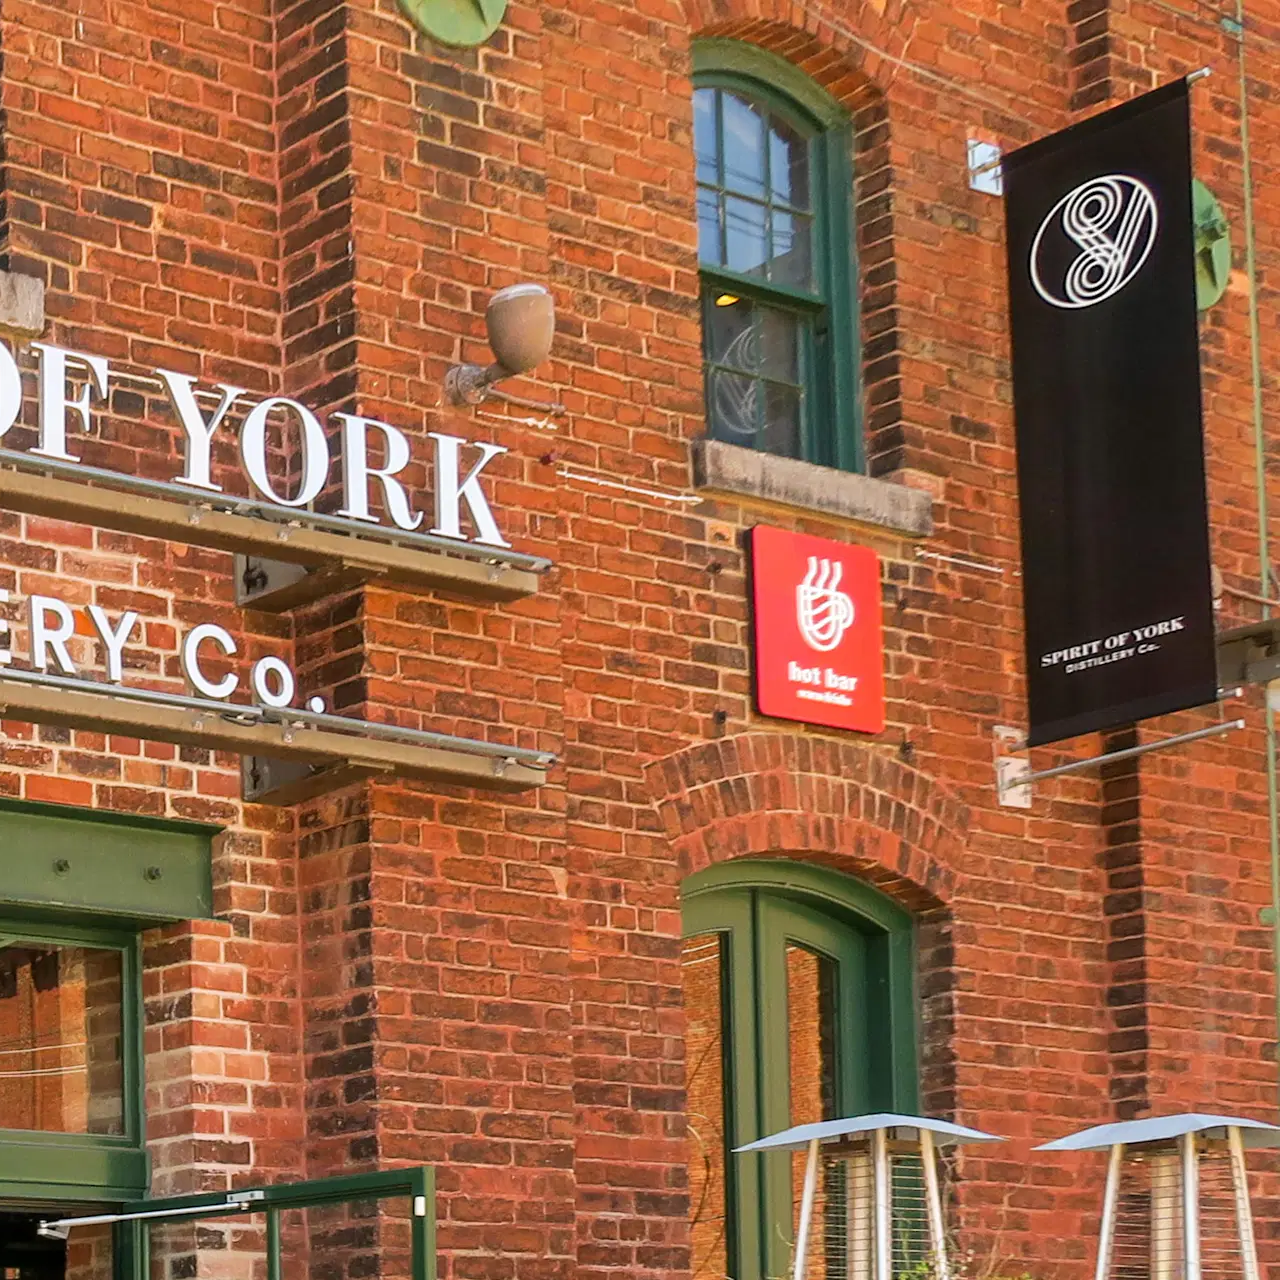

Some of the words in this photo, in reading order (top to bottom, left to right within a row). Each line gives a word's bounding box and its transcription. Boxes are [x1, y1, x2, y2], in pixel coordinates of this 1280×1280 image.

[155, 367, 512, 548] YORK
[1041, 640, 1102, 667] SPIRIT
[1104, 632, 1130, 649] OF
[1133, 616, 1185, 641] YORK
[1065, 648, 1136, 673] DISTILLERY
[1138, 643, 1161, 654] Co.
[182, 622, 327, 714] Co.
[787, 660, 821, 685] hot
[824, 668, 858, 691] bar
